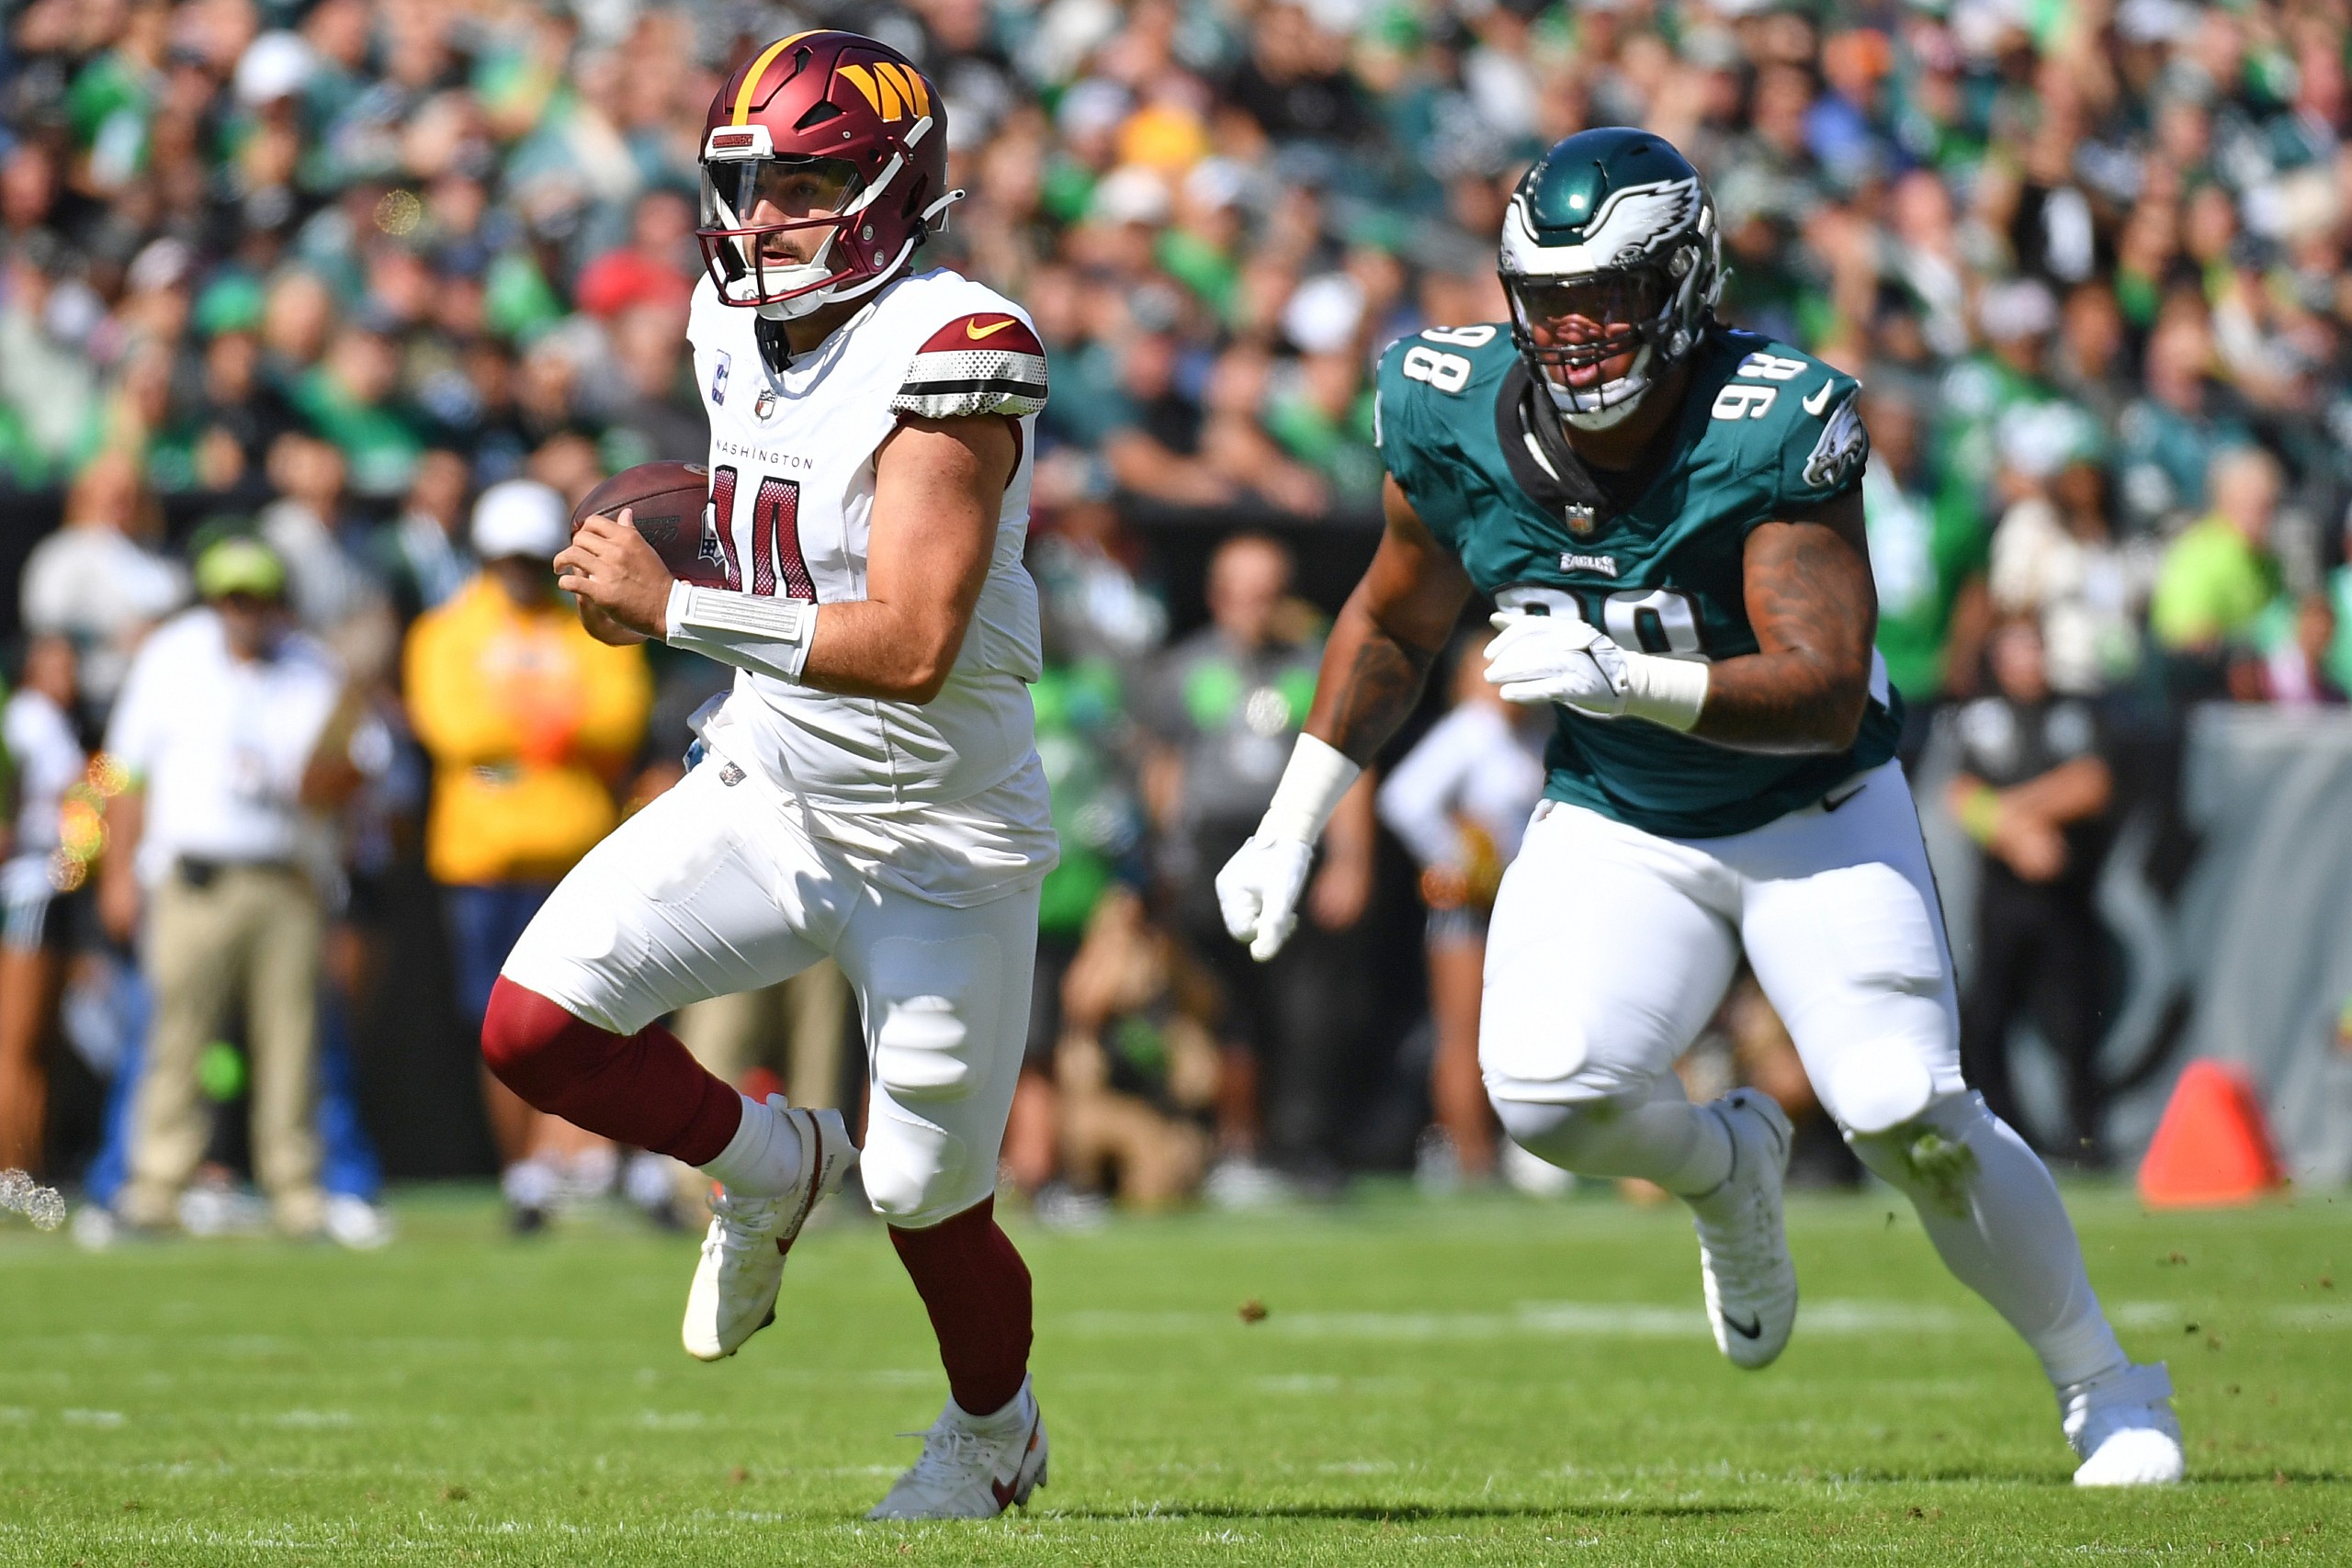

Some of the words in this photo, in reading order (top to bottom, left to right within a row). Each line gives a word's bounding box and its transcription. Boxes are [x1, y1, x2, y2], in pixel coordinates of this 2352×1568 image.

[1403, 325, 1498, 394] 98
[1711, 352, 1809, 421] 98
[1559, 551, 1618, 579] EAGLES
